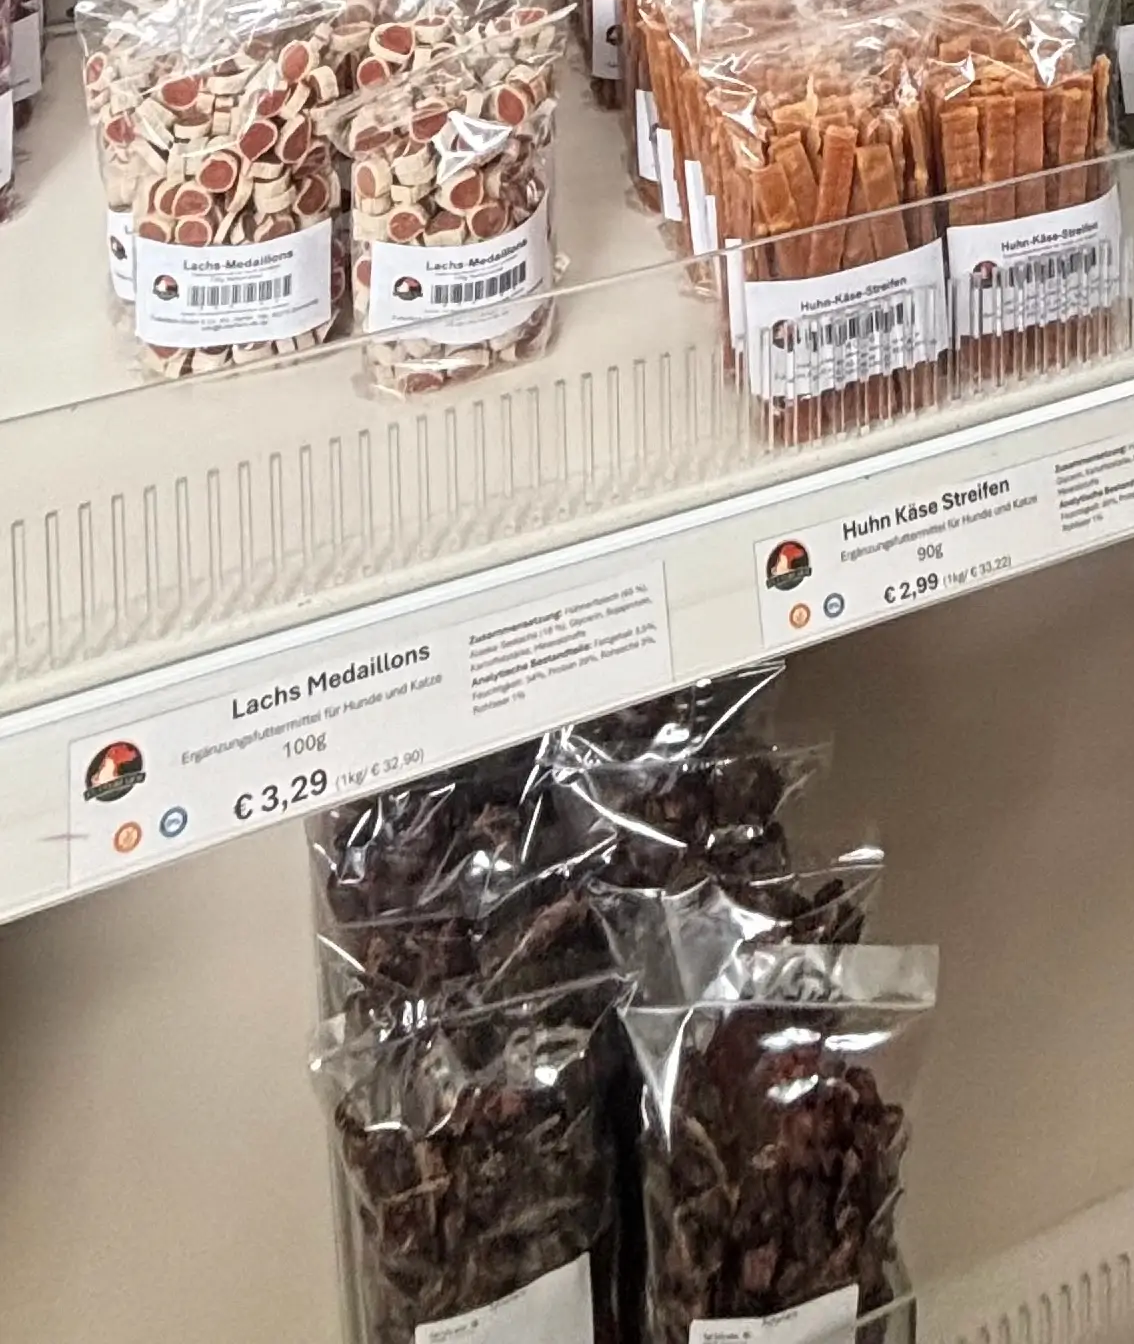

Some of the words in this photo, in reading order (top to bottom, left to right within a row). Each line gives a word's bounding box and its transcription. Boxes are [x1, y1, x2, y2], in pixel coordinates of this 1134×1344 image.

[842, 515, 892, 541] Huhn
[895, 500, 938, 526] Käse
[941, 478, 1011, 511] Streifen
[917, 543, 944, 562] 90g
[900, 572, 939, 601] 2,99
[231, 684, 301, 720] Lachs
[306, 644, 431, 697] Medaillons
[324, 706, 341, 721] für
[342, 692, 383, 715] Hunde
[385, 683, 408, 701] und
[410, 672, 443, 692] Katze
[282, 732, 328, 759] 100g
[260, 768, 328, 814] 3,29
[383, 748, 425, 772] 32,90)
